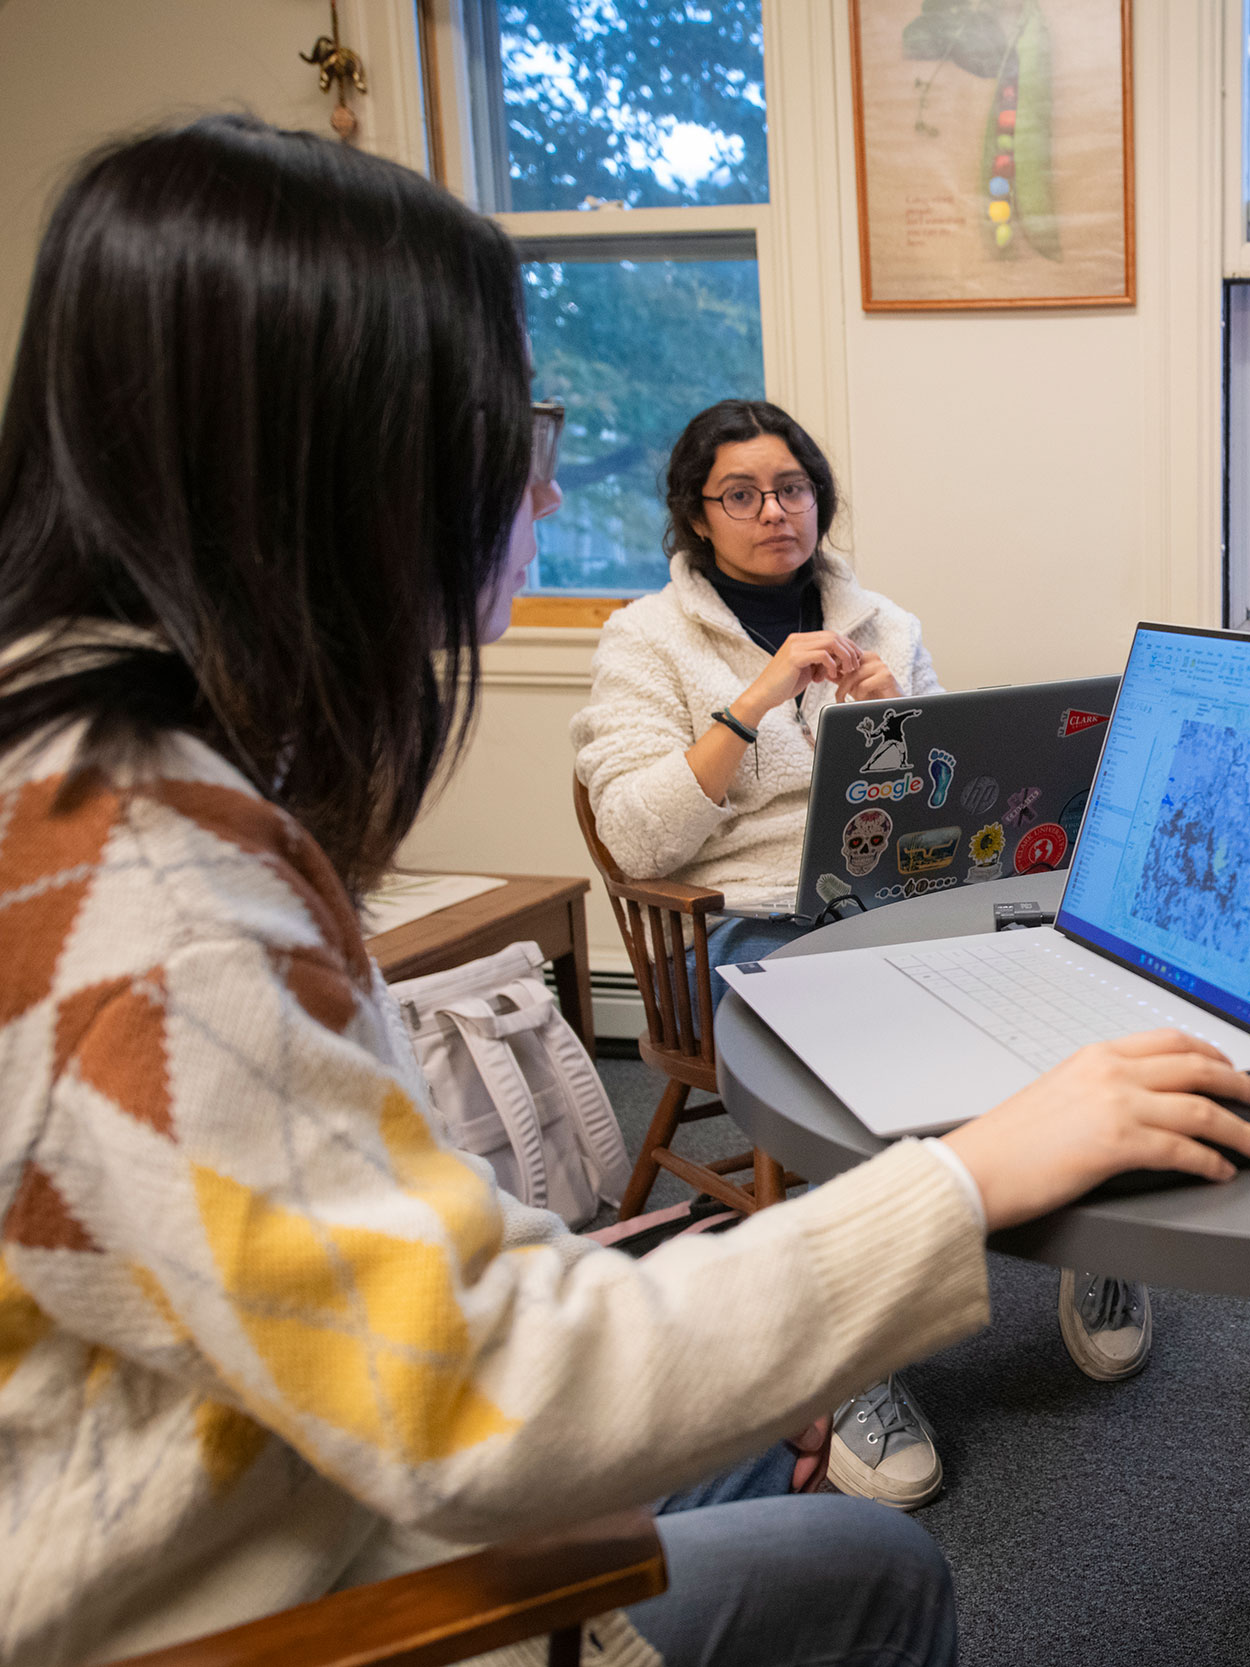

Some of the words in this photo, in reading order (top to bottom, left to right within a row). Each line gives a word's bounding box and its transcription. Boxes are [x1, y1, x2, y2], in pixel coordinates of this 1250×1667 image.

[1069, 715, 1099, 726] CLARK
[849, 775, 922, 799] Google
[1016, 834, 1033, 859] CLARK
[1033, 825, 1066, 848] UNIVERSITY
